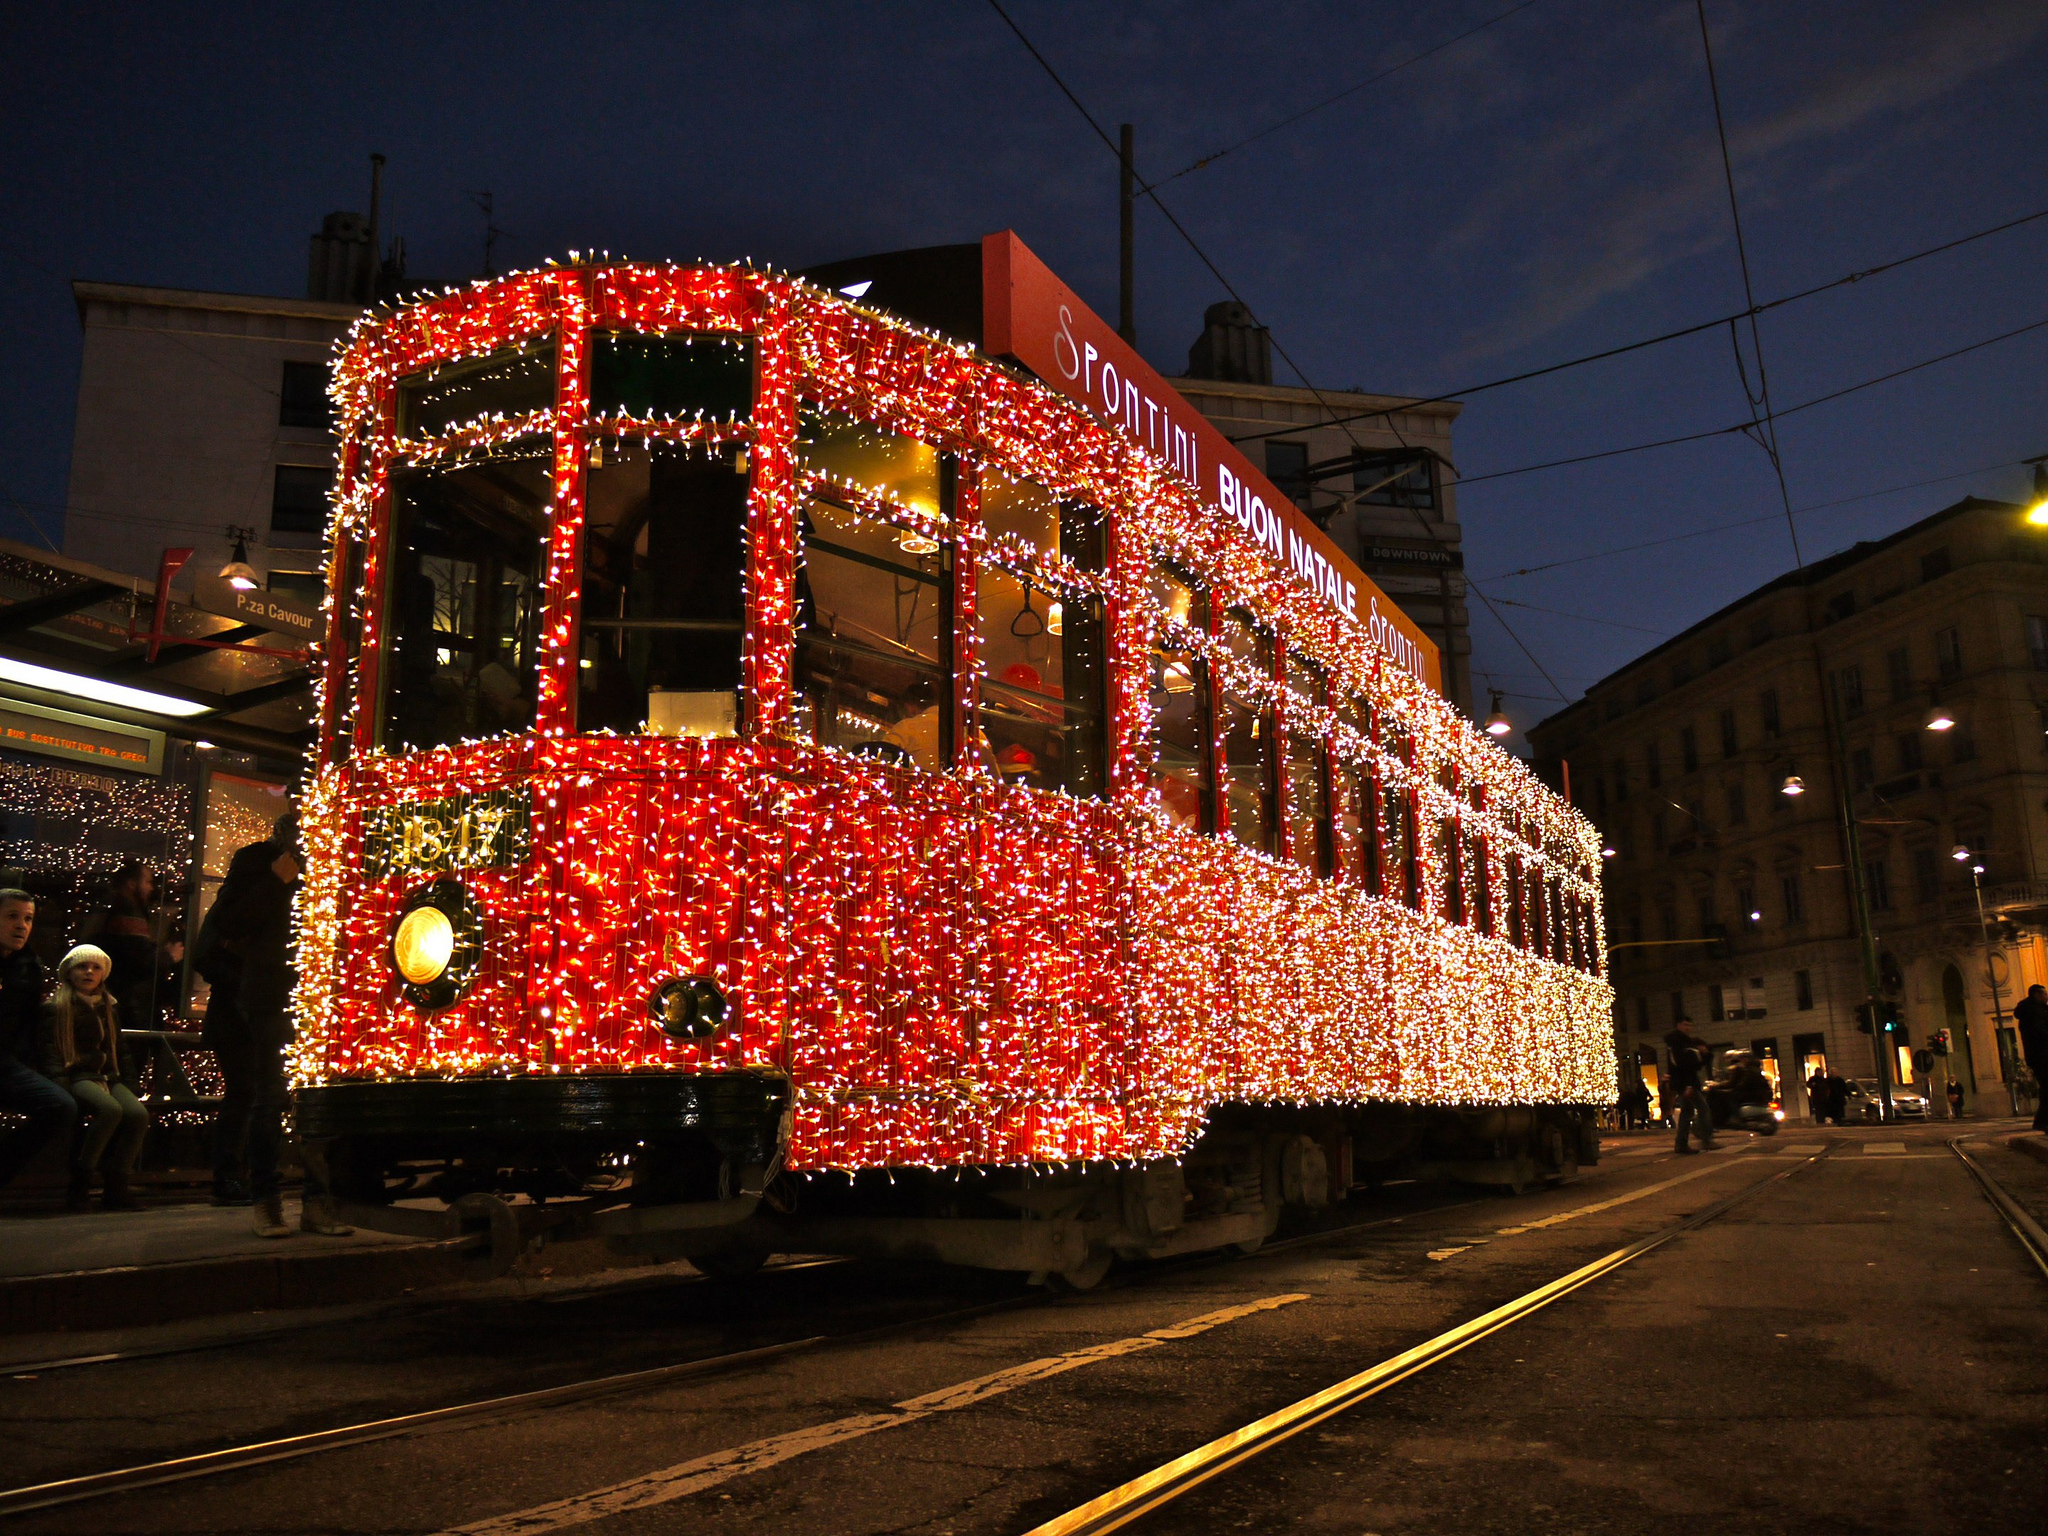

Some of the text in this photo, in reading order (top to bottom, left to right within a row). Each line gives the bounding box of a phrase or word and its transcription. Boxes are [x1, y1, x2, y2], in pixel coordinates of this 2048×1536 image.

[1219, 463, 1284, 560] BUON
[1289, 528, 1358, 622] NATALE
[1372, 548, 1450, 562] DOWNTOWN
[237, 594, 313, 629] P.za Cavour
